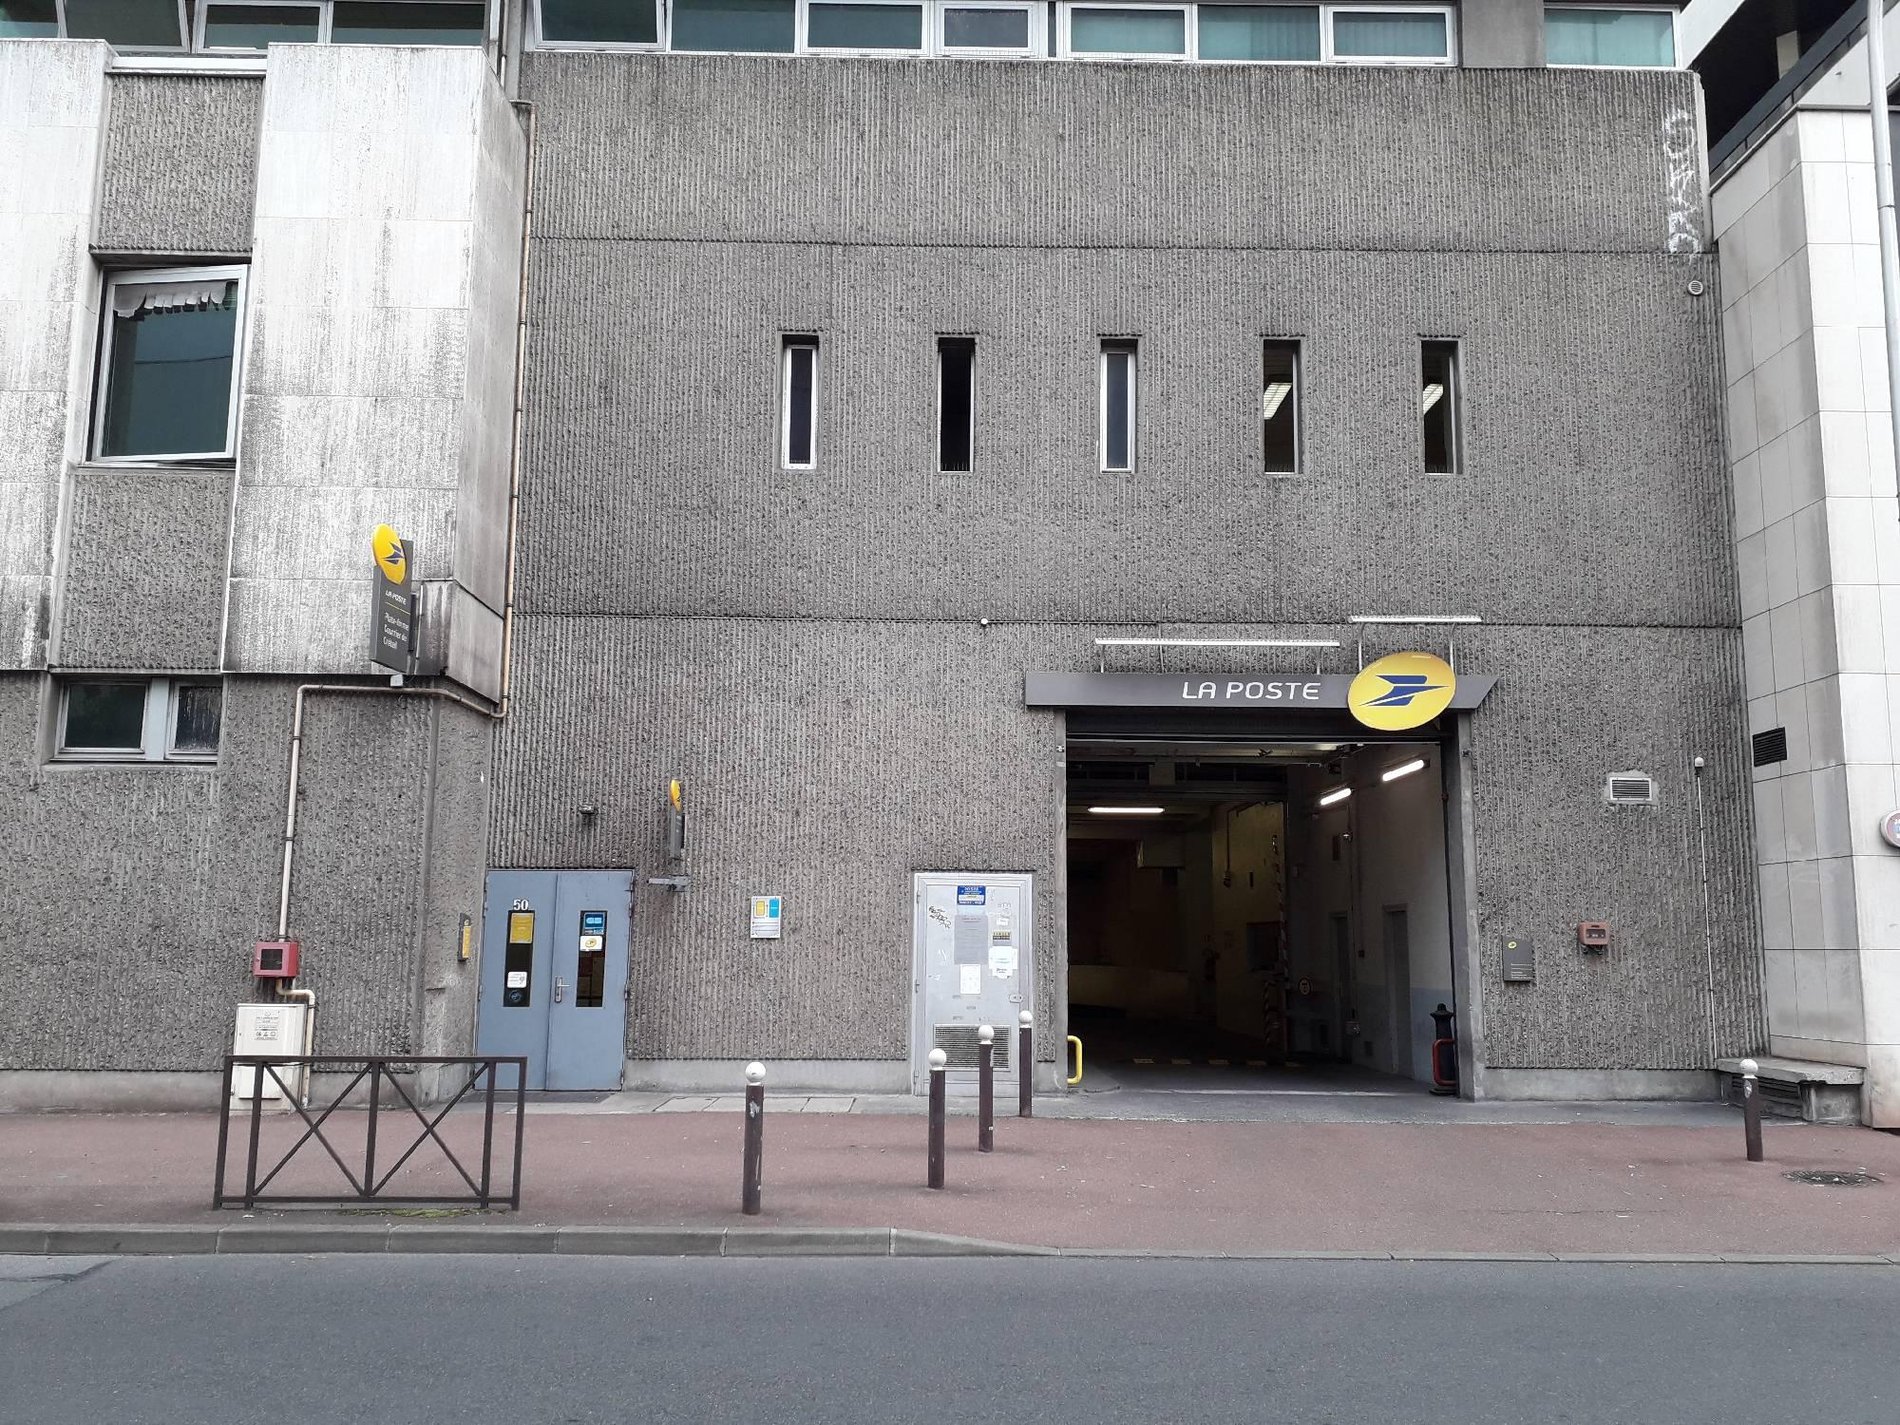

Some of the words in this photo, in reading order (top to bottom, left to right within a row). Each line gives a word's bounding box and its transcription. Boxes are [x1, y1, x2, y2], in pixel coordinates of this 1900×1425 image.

[391, 593, 406, 605] POSTE
[1182, 681, 1217, 699] LA
[1225, 682, 1322, 700] POSTE
[513, 899, 529, 911] 50
